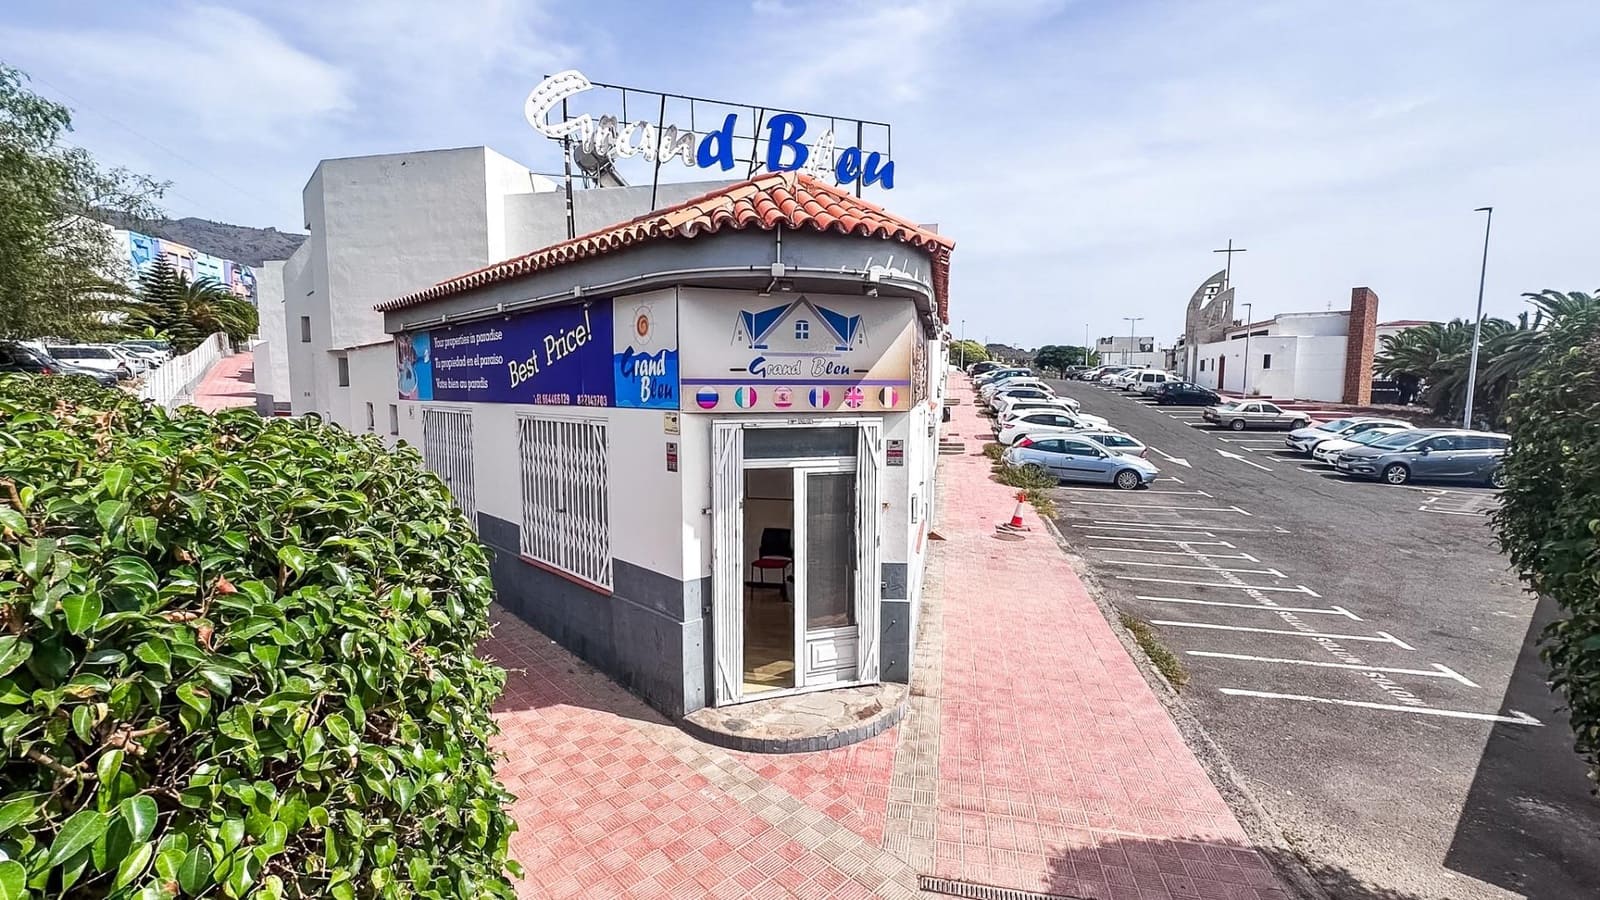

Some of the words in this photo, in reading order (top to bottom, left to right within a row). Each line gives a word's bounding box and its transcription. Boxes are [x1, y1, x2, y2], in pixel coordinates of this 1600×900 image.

[524, 69, 738, 172] Grand
[767, 112, 895, 190] Bleu
[444, 334, 469, 349] properties
[476, 328, 503, 346] paradise
[508, 349, 539, 388] Best
[543, 310, 592, 366] Price!
[441, 355, 466, 370] propiedad
[474, 353, 480, 366] el
[620, 345, 666, 384] Grand
[749, 356, 802, 378] Grand
[811, 356, 850, 378] Bleu
[447, 377, 459, 389] bien
[468, 376, 489, 391] paradis
[641, 375, 673, 403] Bleu
